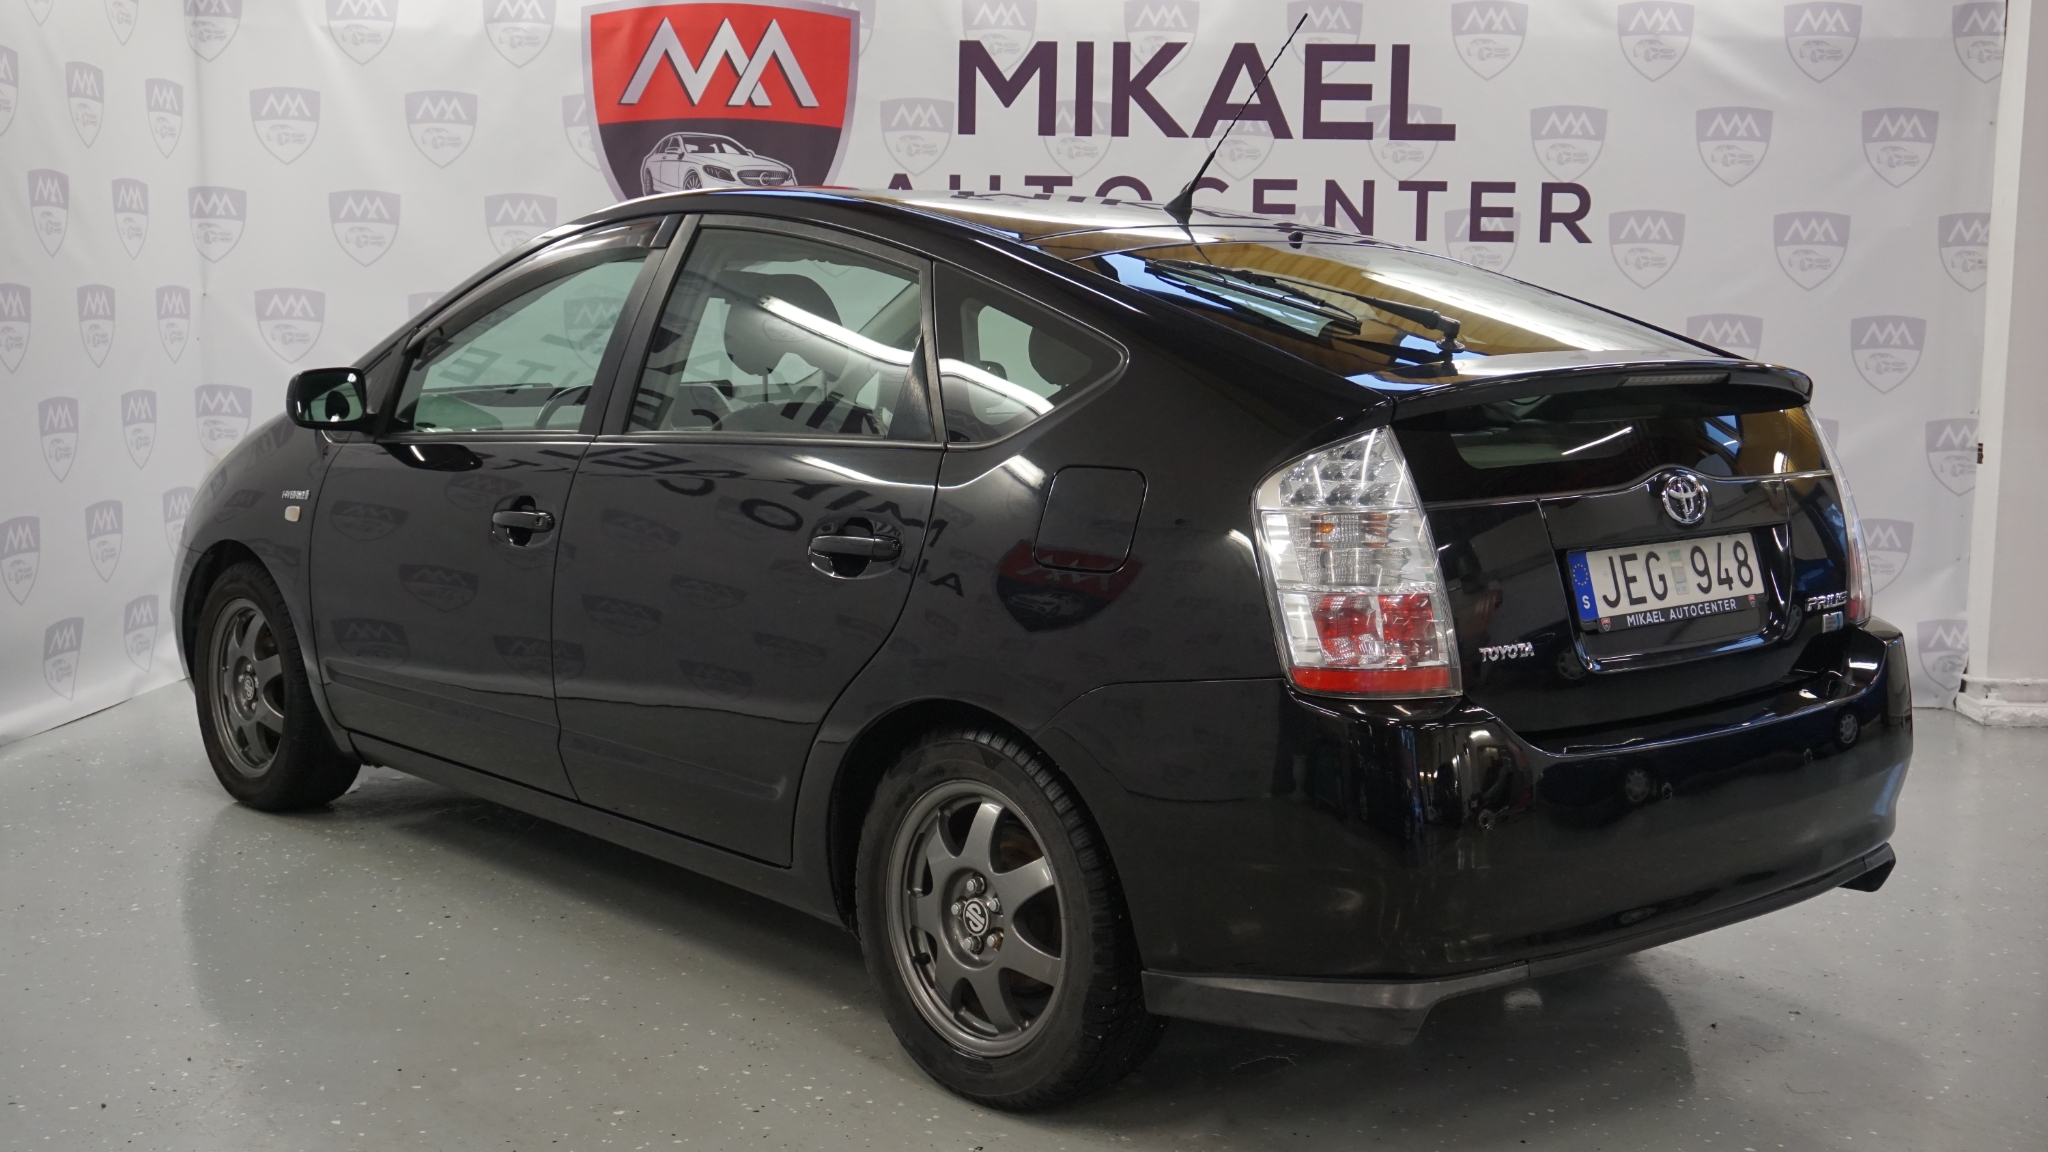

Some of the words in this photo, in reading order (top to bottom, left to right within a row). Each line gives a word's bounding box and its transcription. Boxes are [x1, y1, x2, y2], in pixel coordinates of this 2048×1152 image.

[957, 39, 1456, 142] MIKAEL
[887, 172, 1592, 244] TENTER
[1602, 550, 1669, 609] JEG
[1690, 540, 1754, 595] 948
[1582, 594, 1591, 610] S
[1626, 611, 1666, 627] MIKAEL
[1669, 598, 1738, 621] AUTOCENTER
[1478, 641, 1535, 662] TOYOTA
